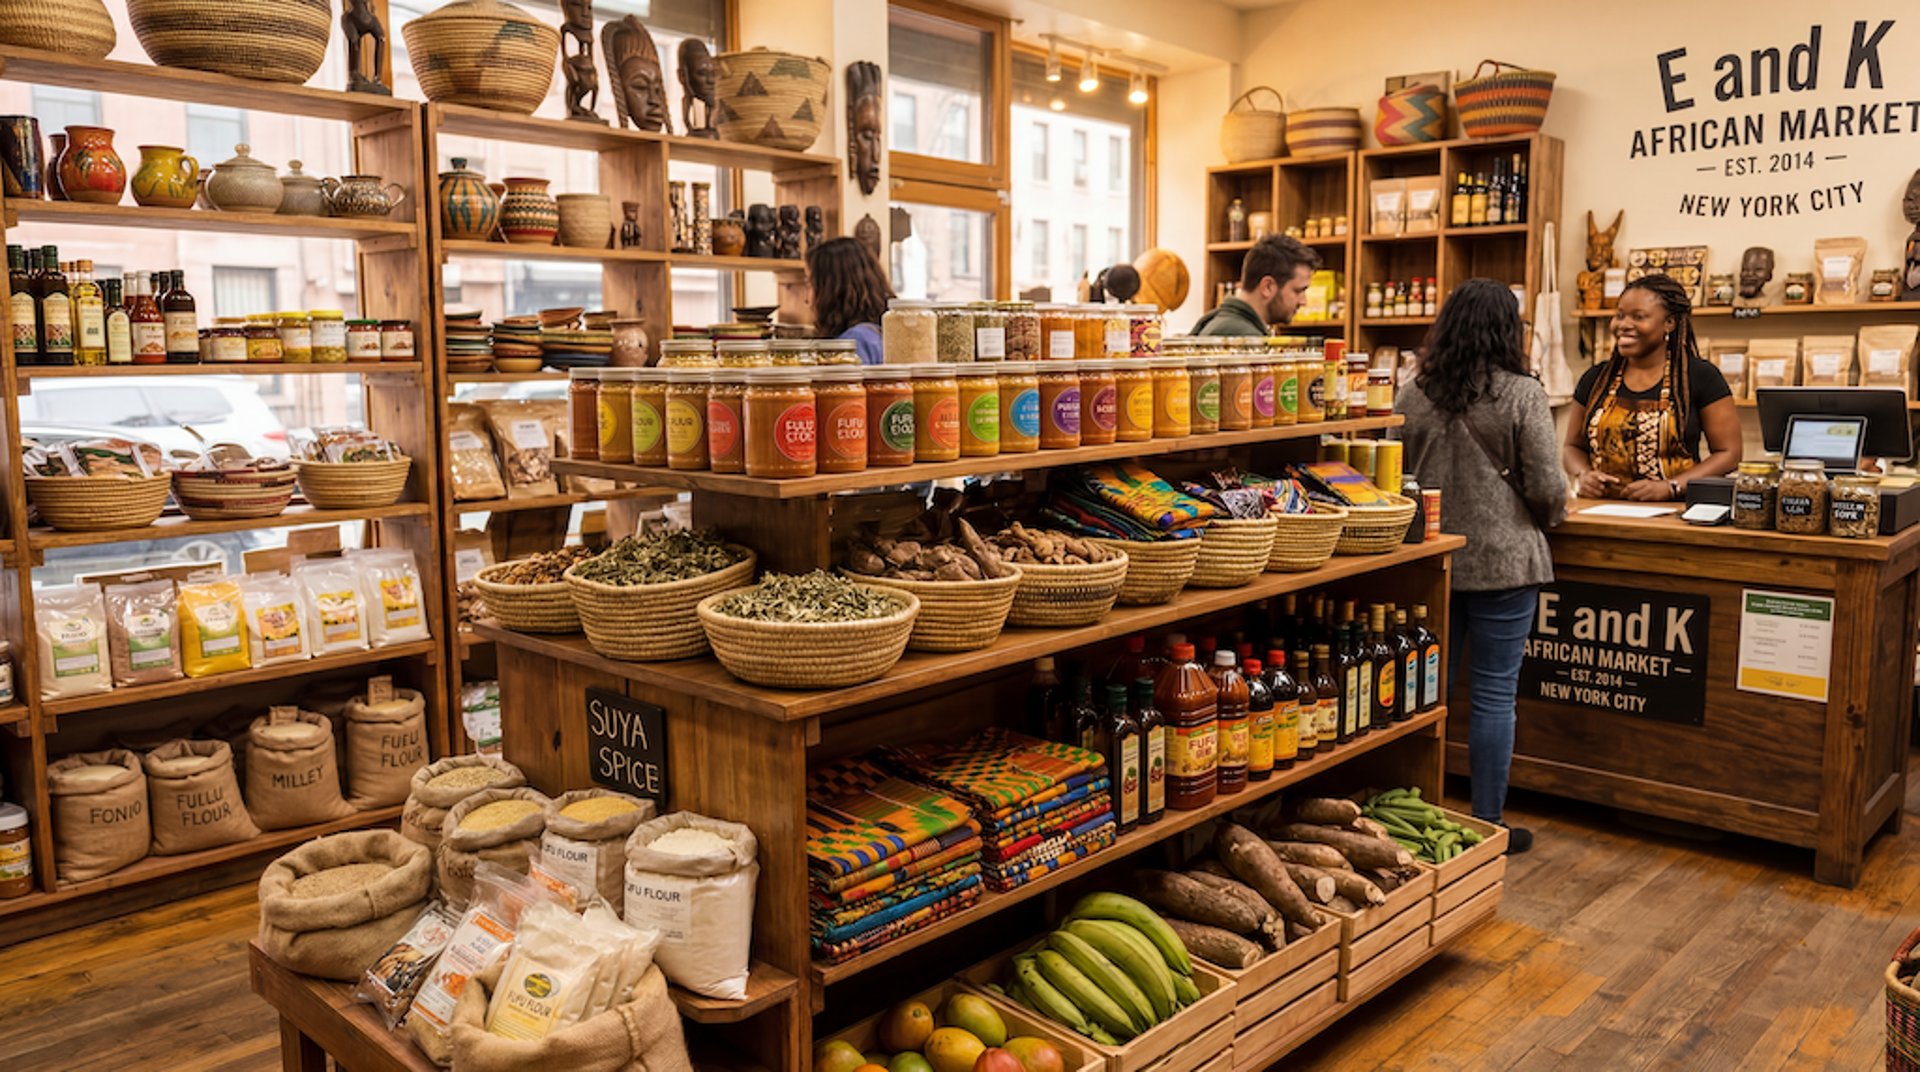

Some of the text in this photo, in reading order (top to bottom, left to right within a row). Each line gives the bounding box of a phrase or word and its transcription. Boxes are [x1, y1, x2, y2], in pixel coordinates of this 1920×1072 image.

[1657, 20, 1896, 113] E and K
[1629, 101, 1920, 159] AFRICAN MARKET
[1724, 151, 1815, 177] EST. 2014
[1679, 181, 1864, 218] NEW YORK CITY
[1538, 591, 1694, 655] E and K
[1522, 638, 1672, 678] AFRICAN MARKET
[1570, 668, 1622, 688] EST. 2014
[1540, 681, 1647, 713] NEW YORK CITY
[590, 699, 648, 750] SUYA
[599, 746, 660, 794] SPICE
[89, 800, 142, 825] FONIO
[181, 802, 232, 826] FLOUR
[556, 848, 589, 863] FLOUR
[644, 887, 681, 903] FLOUR
